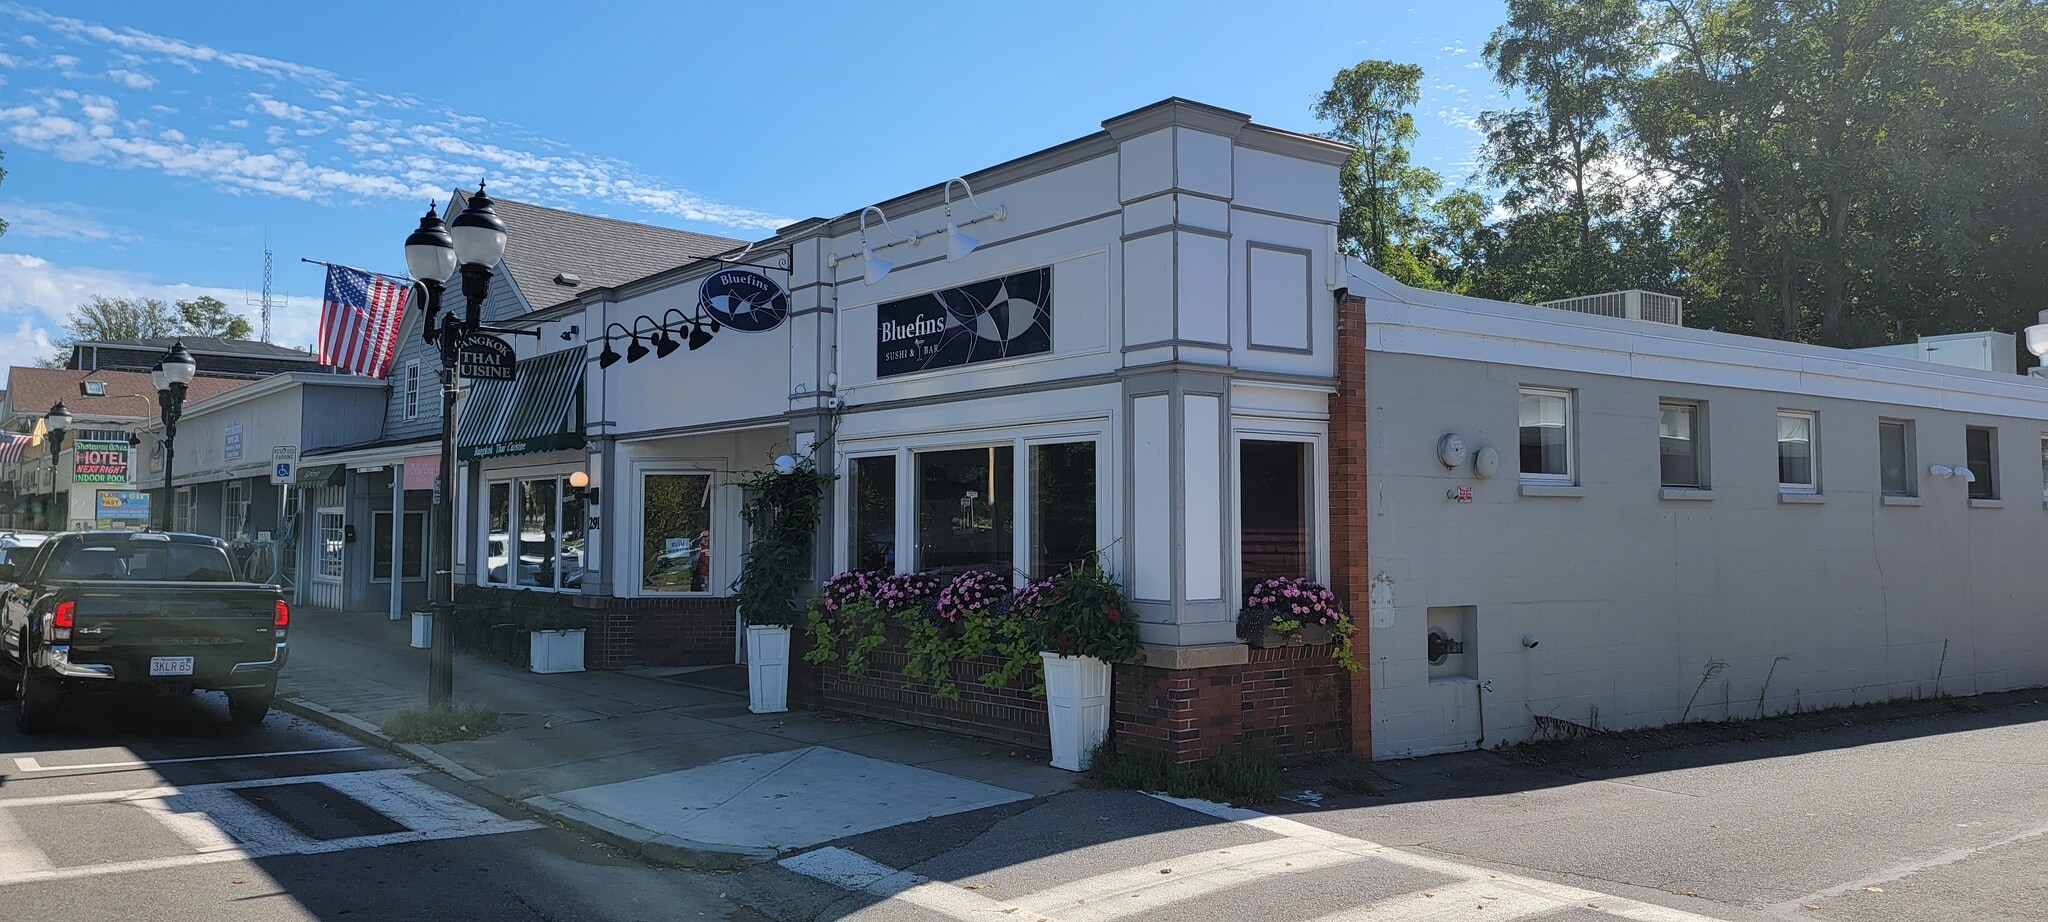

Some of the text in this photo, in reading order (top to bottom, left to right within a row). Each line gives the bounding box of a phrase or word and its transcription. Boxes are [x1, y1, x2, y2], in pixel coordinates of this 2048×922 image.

[720, 273, 769, 292] Bluefins
[881, 313, 945, 343] Bluefins
[460, 336, 511, 357] ANGKOK
[885, 344, 939, 361] SUSHI & BAR
[460, 351, 501, 366] THAI
[460, 364, 511, 378] UISINE
[76, 451, 127, 465] HOTEL
[76, 465, 126, 474] NEXT RIGHT
[75, 474, 105, 482] INDOOR
[588, 516, 600, 530] 291
[152, 661, 191, 672] 3KLR 85
